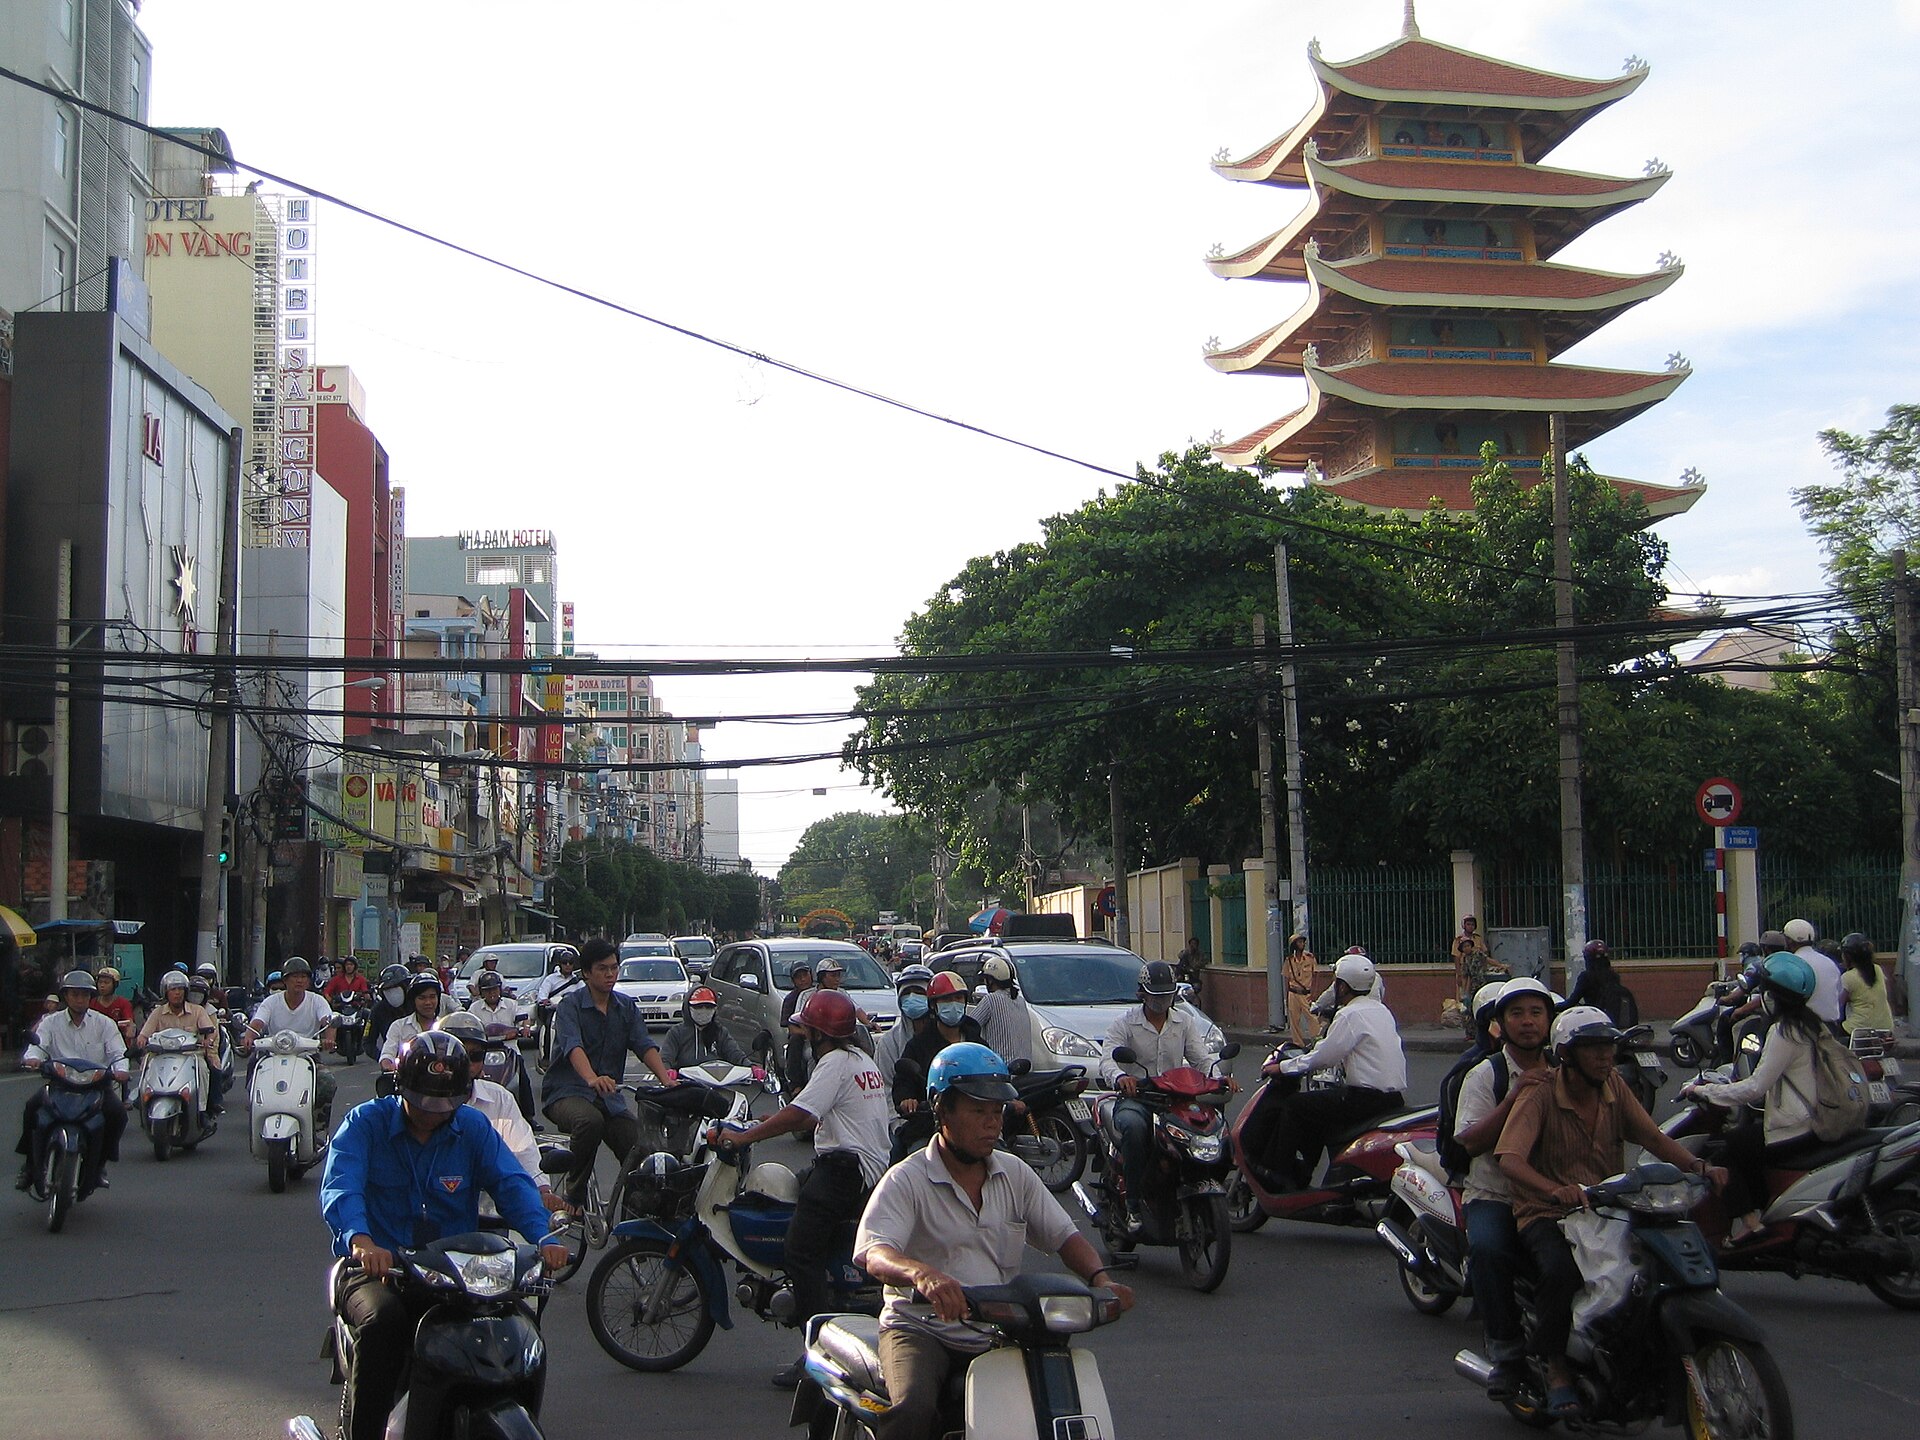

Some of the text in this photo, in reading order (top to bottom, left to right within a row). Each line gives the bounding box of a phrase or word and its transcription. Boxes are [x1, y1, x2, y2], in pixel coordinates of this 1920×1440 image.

[286, 199, 309, 340] HOTEL
[512, 529, 550, 547] HOTEL
[578, 680, 599, 689] DONA
[601, 679, 626, 689] HOTEL
